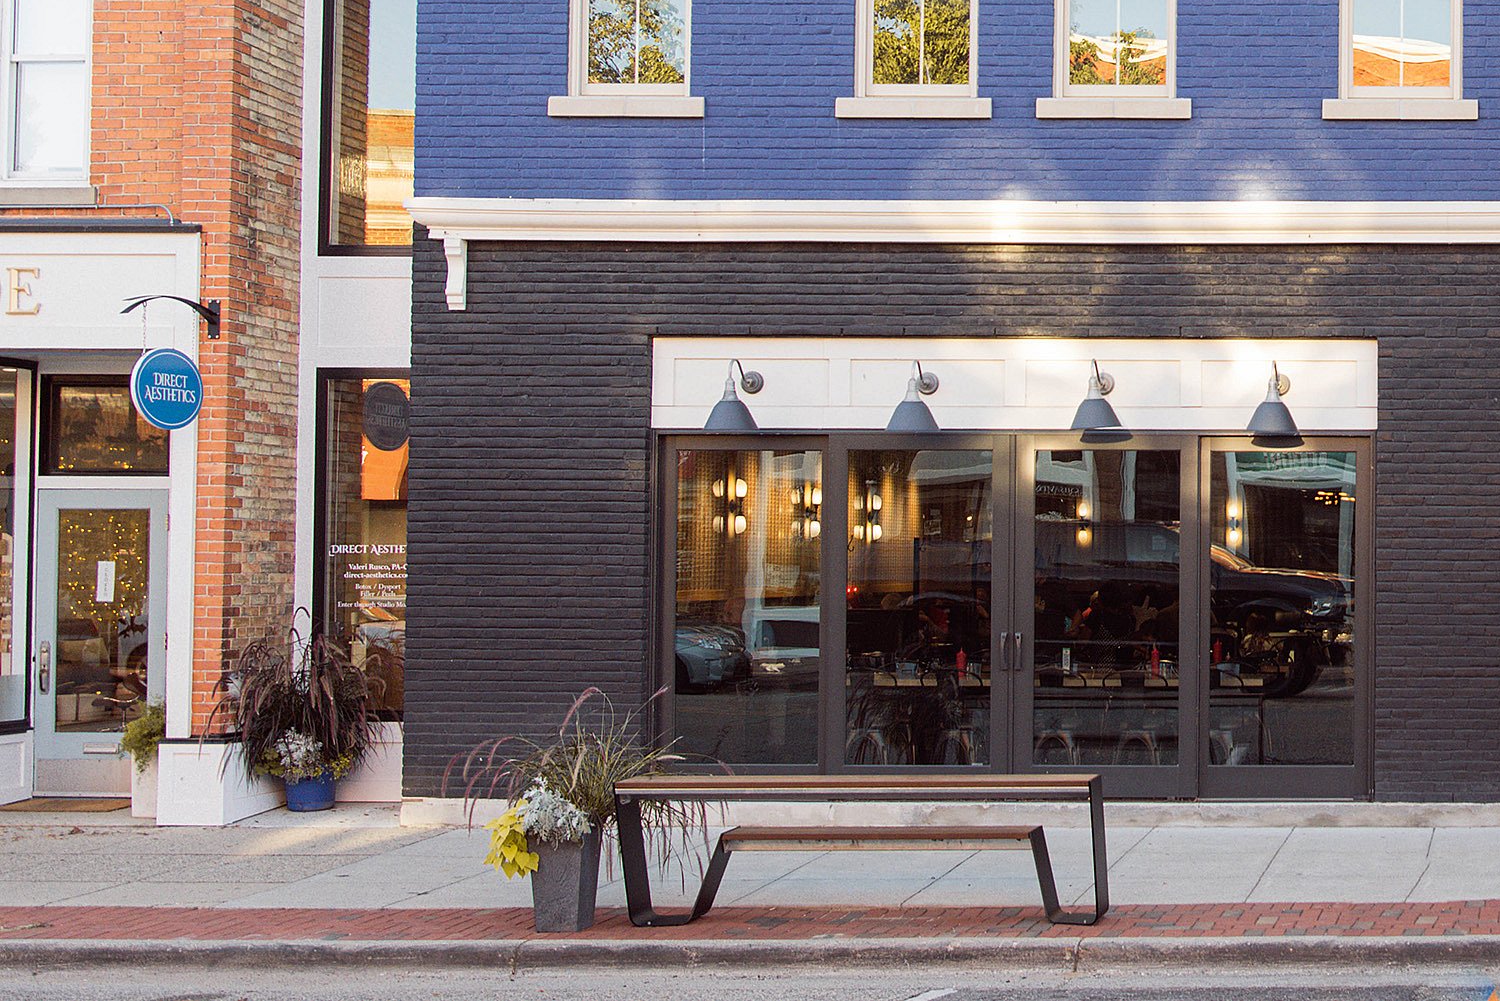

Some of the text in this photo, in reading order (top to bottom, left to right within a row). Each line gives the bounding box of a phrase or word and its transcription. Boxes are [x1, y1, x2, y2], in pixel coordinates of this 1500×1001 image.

[153, 372, 188, 388] DIRECT
[144, 385, 196, 403] AESTHETICS
[328, 544, 369, 556] DIRECT
[348, 563, 368, 571] Valeri
[378, 583, 401, 591] Dysport
